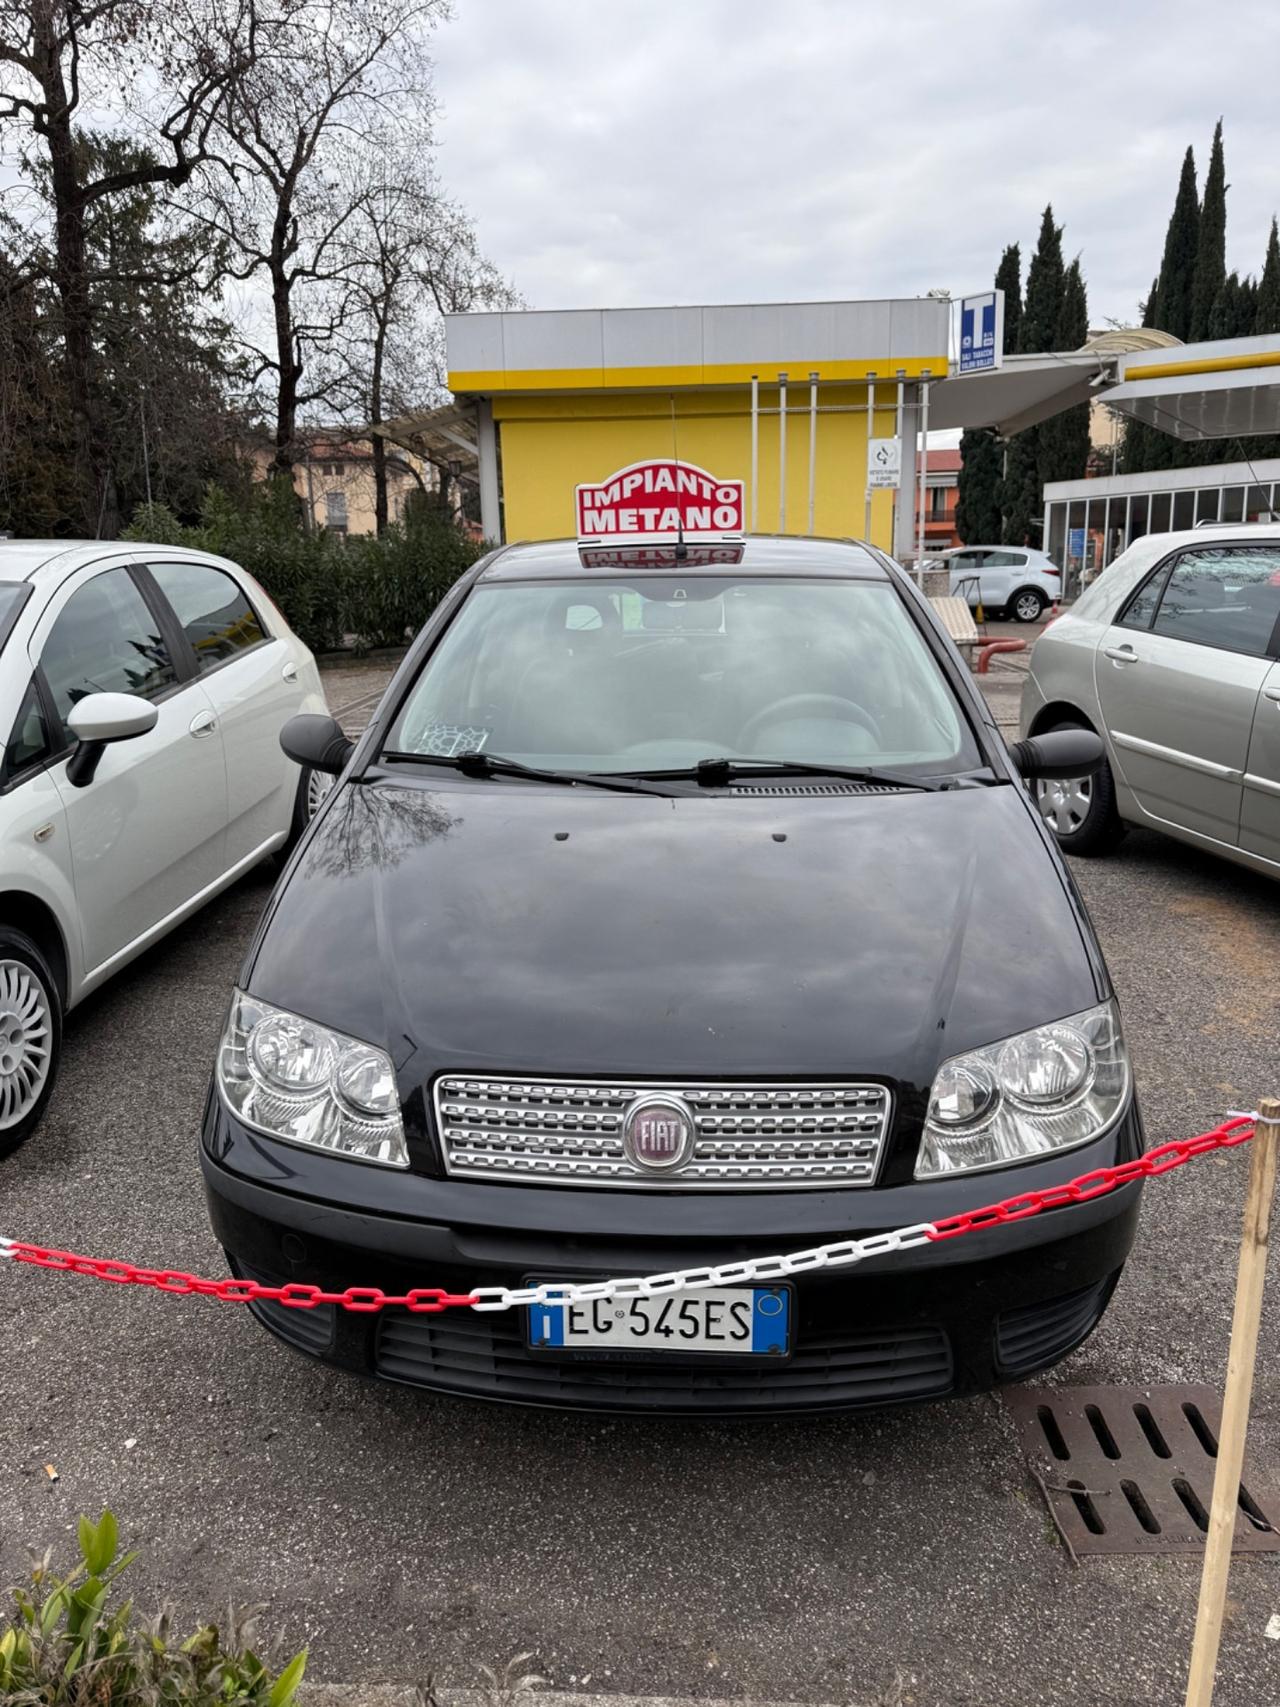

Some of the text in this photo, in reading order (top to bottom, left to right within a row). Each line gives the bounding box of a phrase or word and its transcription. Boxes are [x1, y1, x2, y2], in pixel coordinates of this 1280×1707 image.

[964, 293, 994, 349] T
[583, 468, 739, 507] IMPIANTO
[583, 505, 738, 533] METANO
[641, 1120, 679, 1151] FIAT
[569, 1298, 613, 1335] EG
[629, 1297, 751, 1341] 545ES
